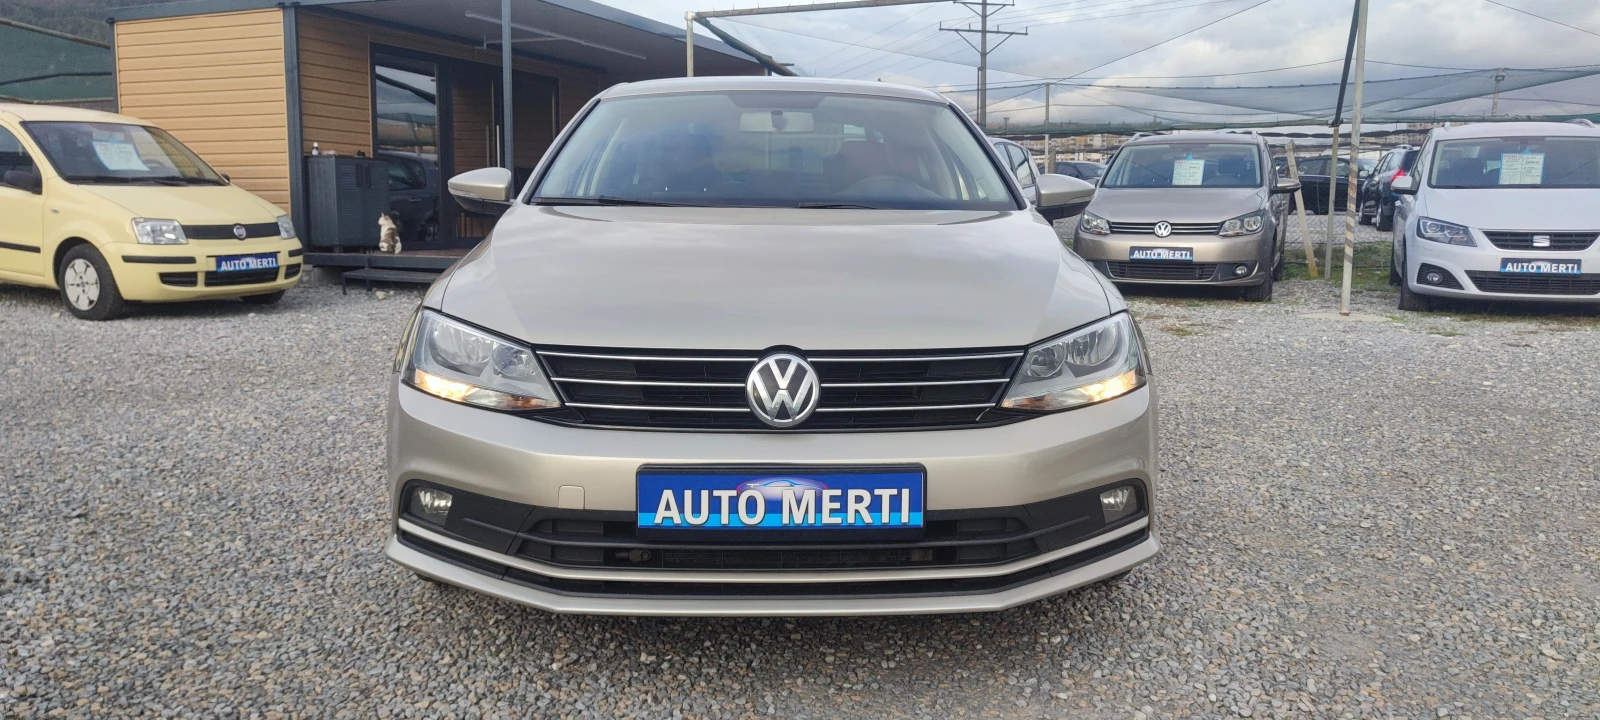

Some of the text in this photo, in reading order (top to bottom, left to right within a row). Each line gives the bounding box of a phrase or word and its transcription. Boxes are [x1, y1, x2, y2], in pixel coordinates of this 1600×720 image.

[1132, 250, 1190, 260] AUTO MERTI
[220, 257, 277, 271] AUTO MERTI
[1504, 262, 1578, 273] AUTO MERTI
[747, 353, 819, 427] VW
[653, 488, 910, 525] AUTO MERTI
